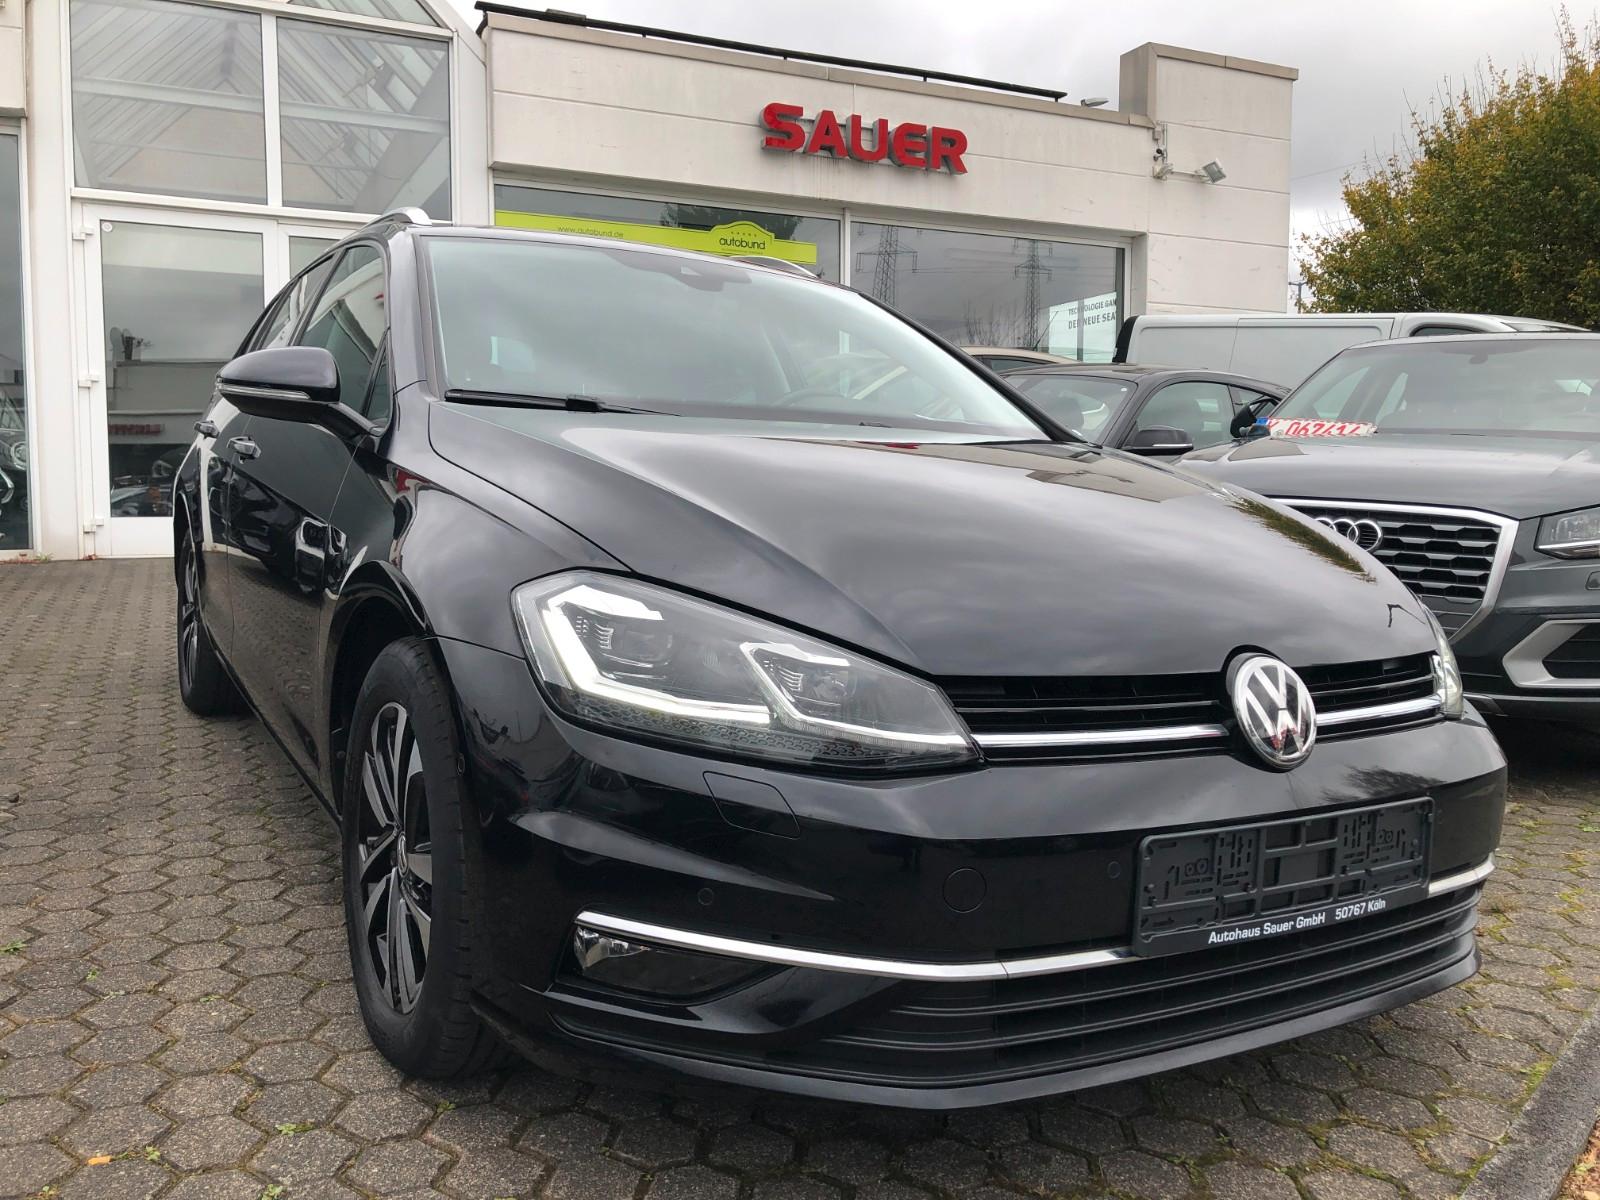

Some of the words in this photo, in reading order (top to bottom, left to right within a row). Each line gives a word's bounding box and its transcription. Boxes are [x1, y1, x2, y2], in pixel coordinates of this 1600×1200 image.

[760, 102, 968, 174] SAUER
[558, 226, 624, 238] www.autobund.de
[719, 237, 766, 250] autobund
[1068, 301, 1105, 317] TECOLOGIE
[1102, 311, 1117, 322] SEA
[1208, 928, 1261, 944] Autohaus
[1263, 920, 1295, 935] Sauer
[1296, 911, 1326, 929] GmbH
[1335, 903, 1366, 920] 50767
[1367, 898, 1387, 913] Köln
